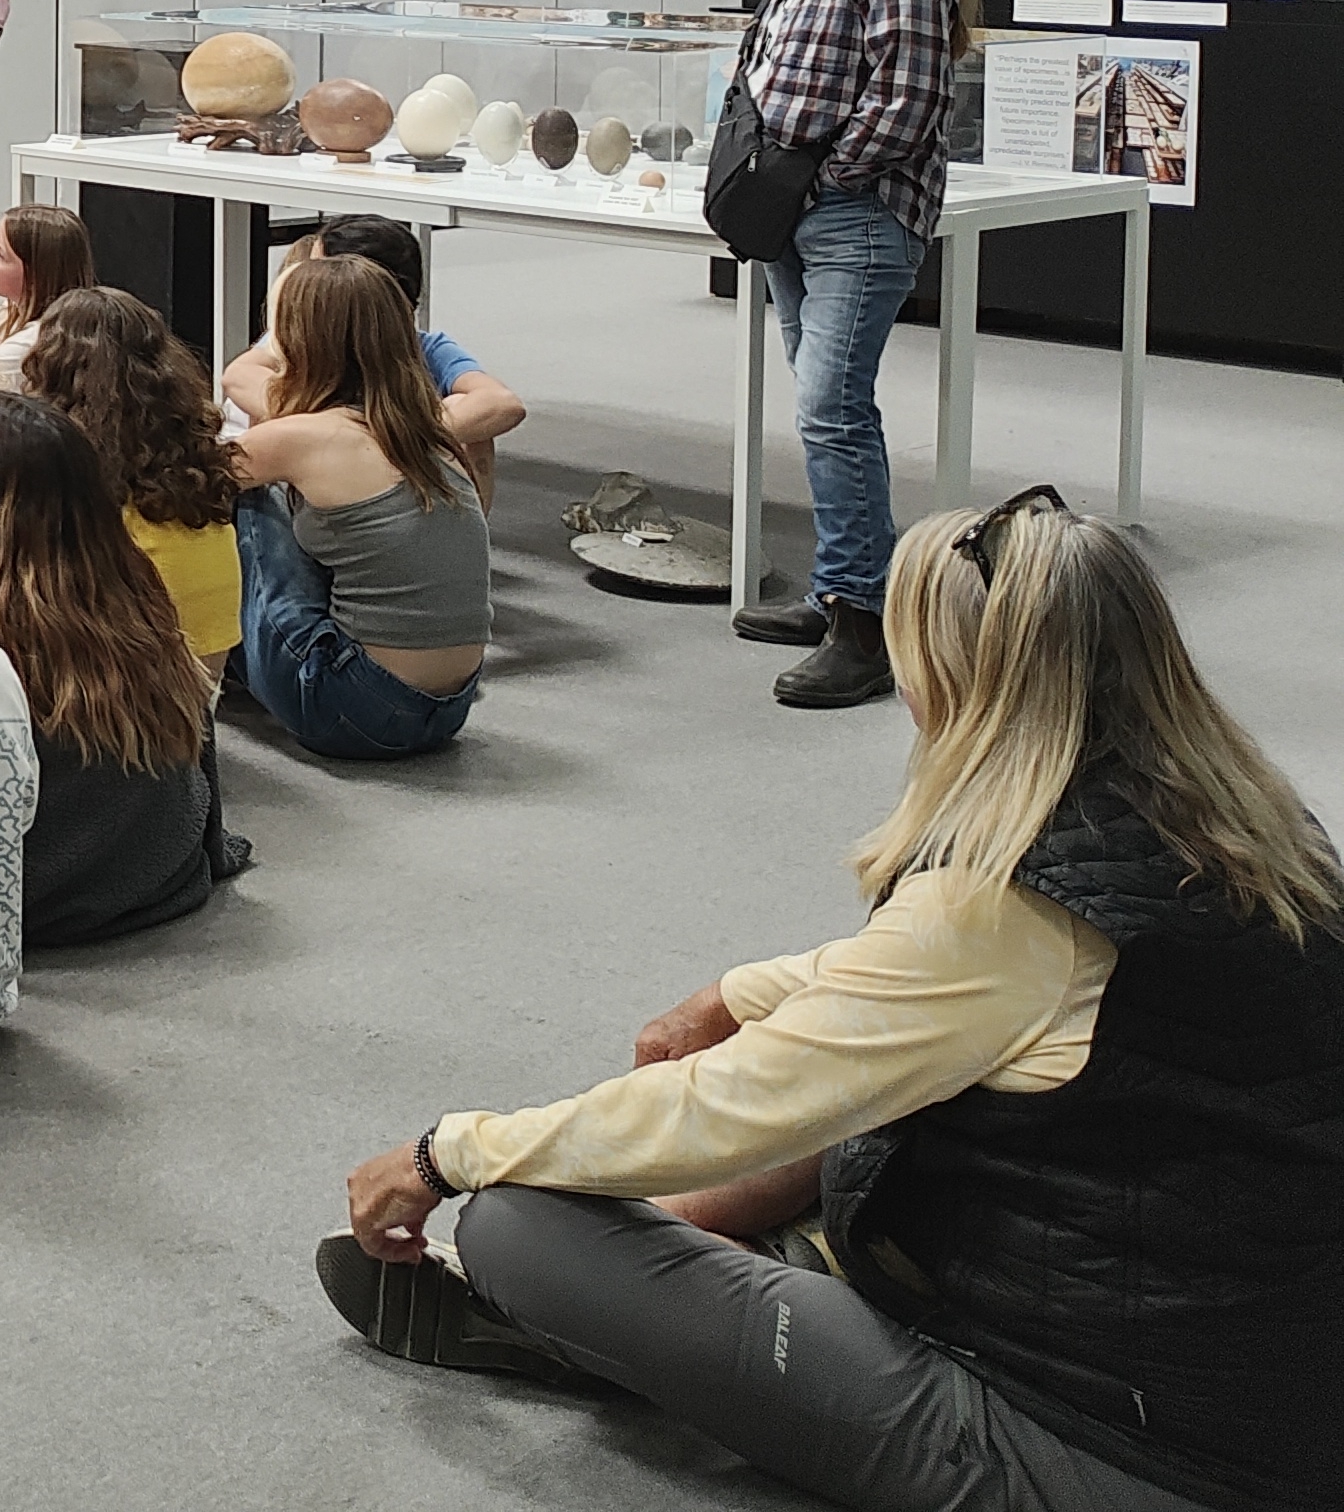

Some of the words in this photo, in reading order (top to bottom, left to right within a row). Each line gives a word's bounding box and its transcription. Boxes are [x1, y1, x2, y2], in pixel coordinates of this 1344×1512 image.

[995, 86, 1024, 94] research
[1030, 99, 1054, 107] predict
[1000, 105, 1019, 113] future
[1001, 128, 1030, 136] research
[1039, 129, 1050, 137] full
[1051, 130, 1059, 138] of
[774, 1301, 791, 1375] BALEAF
